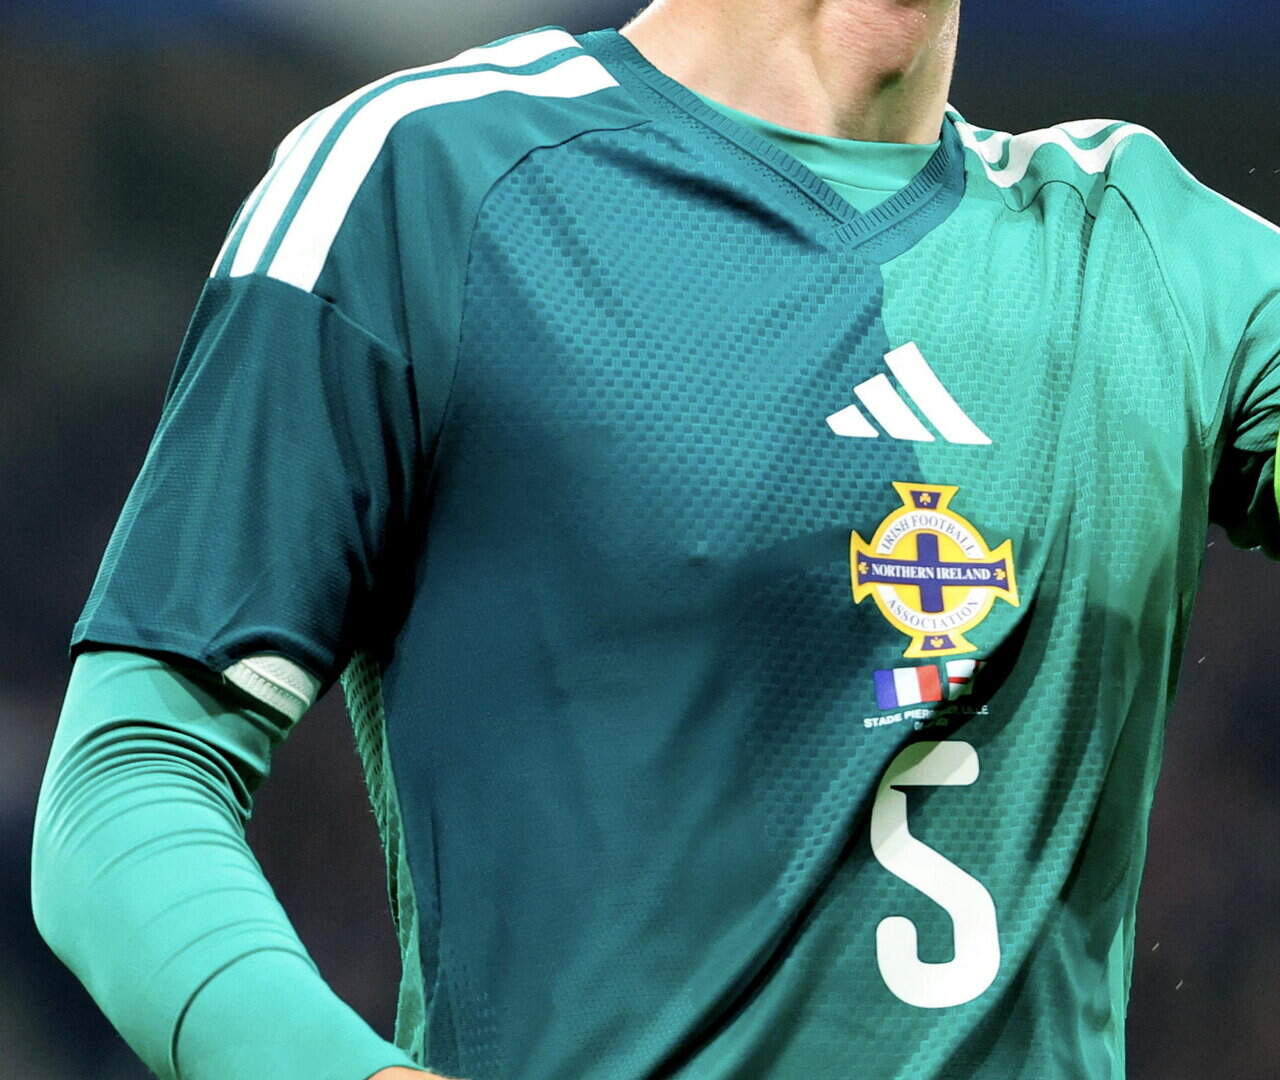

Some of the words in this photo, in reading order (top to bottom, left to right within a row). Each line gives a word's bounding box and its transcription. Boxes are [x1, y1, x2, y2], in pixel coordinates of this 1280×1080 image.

[881, 520, 909, 551] IRISH
[911, 514, 976, 552] FOOTBALL
[871, 563, 935, 579] NORTHERN
[936, 566, 991, 580] IRELAND
[888, 598, 979, 630] ASSOCIATION
[863, 713, 902, 729] STADE
[871, 740, 1001, 1009] 5
